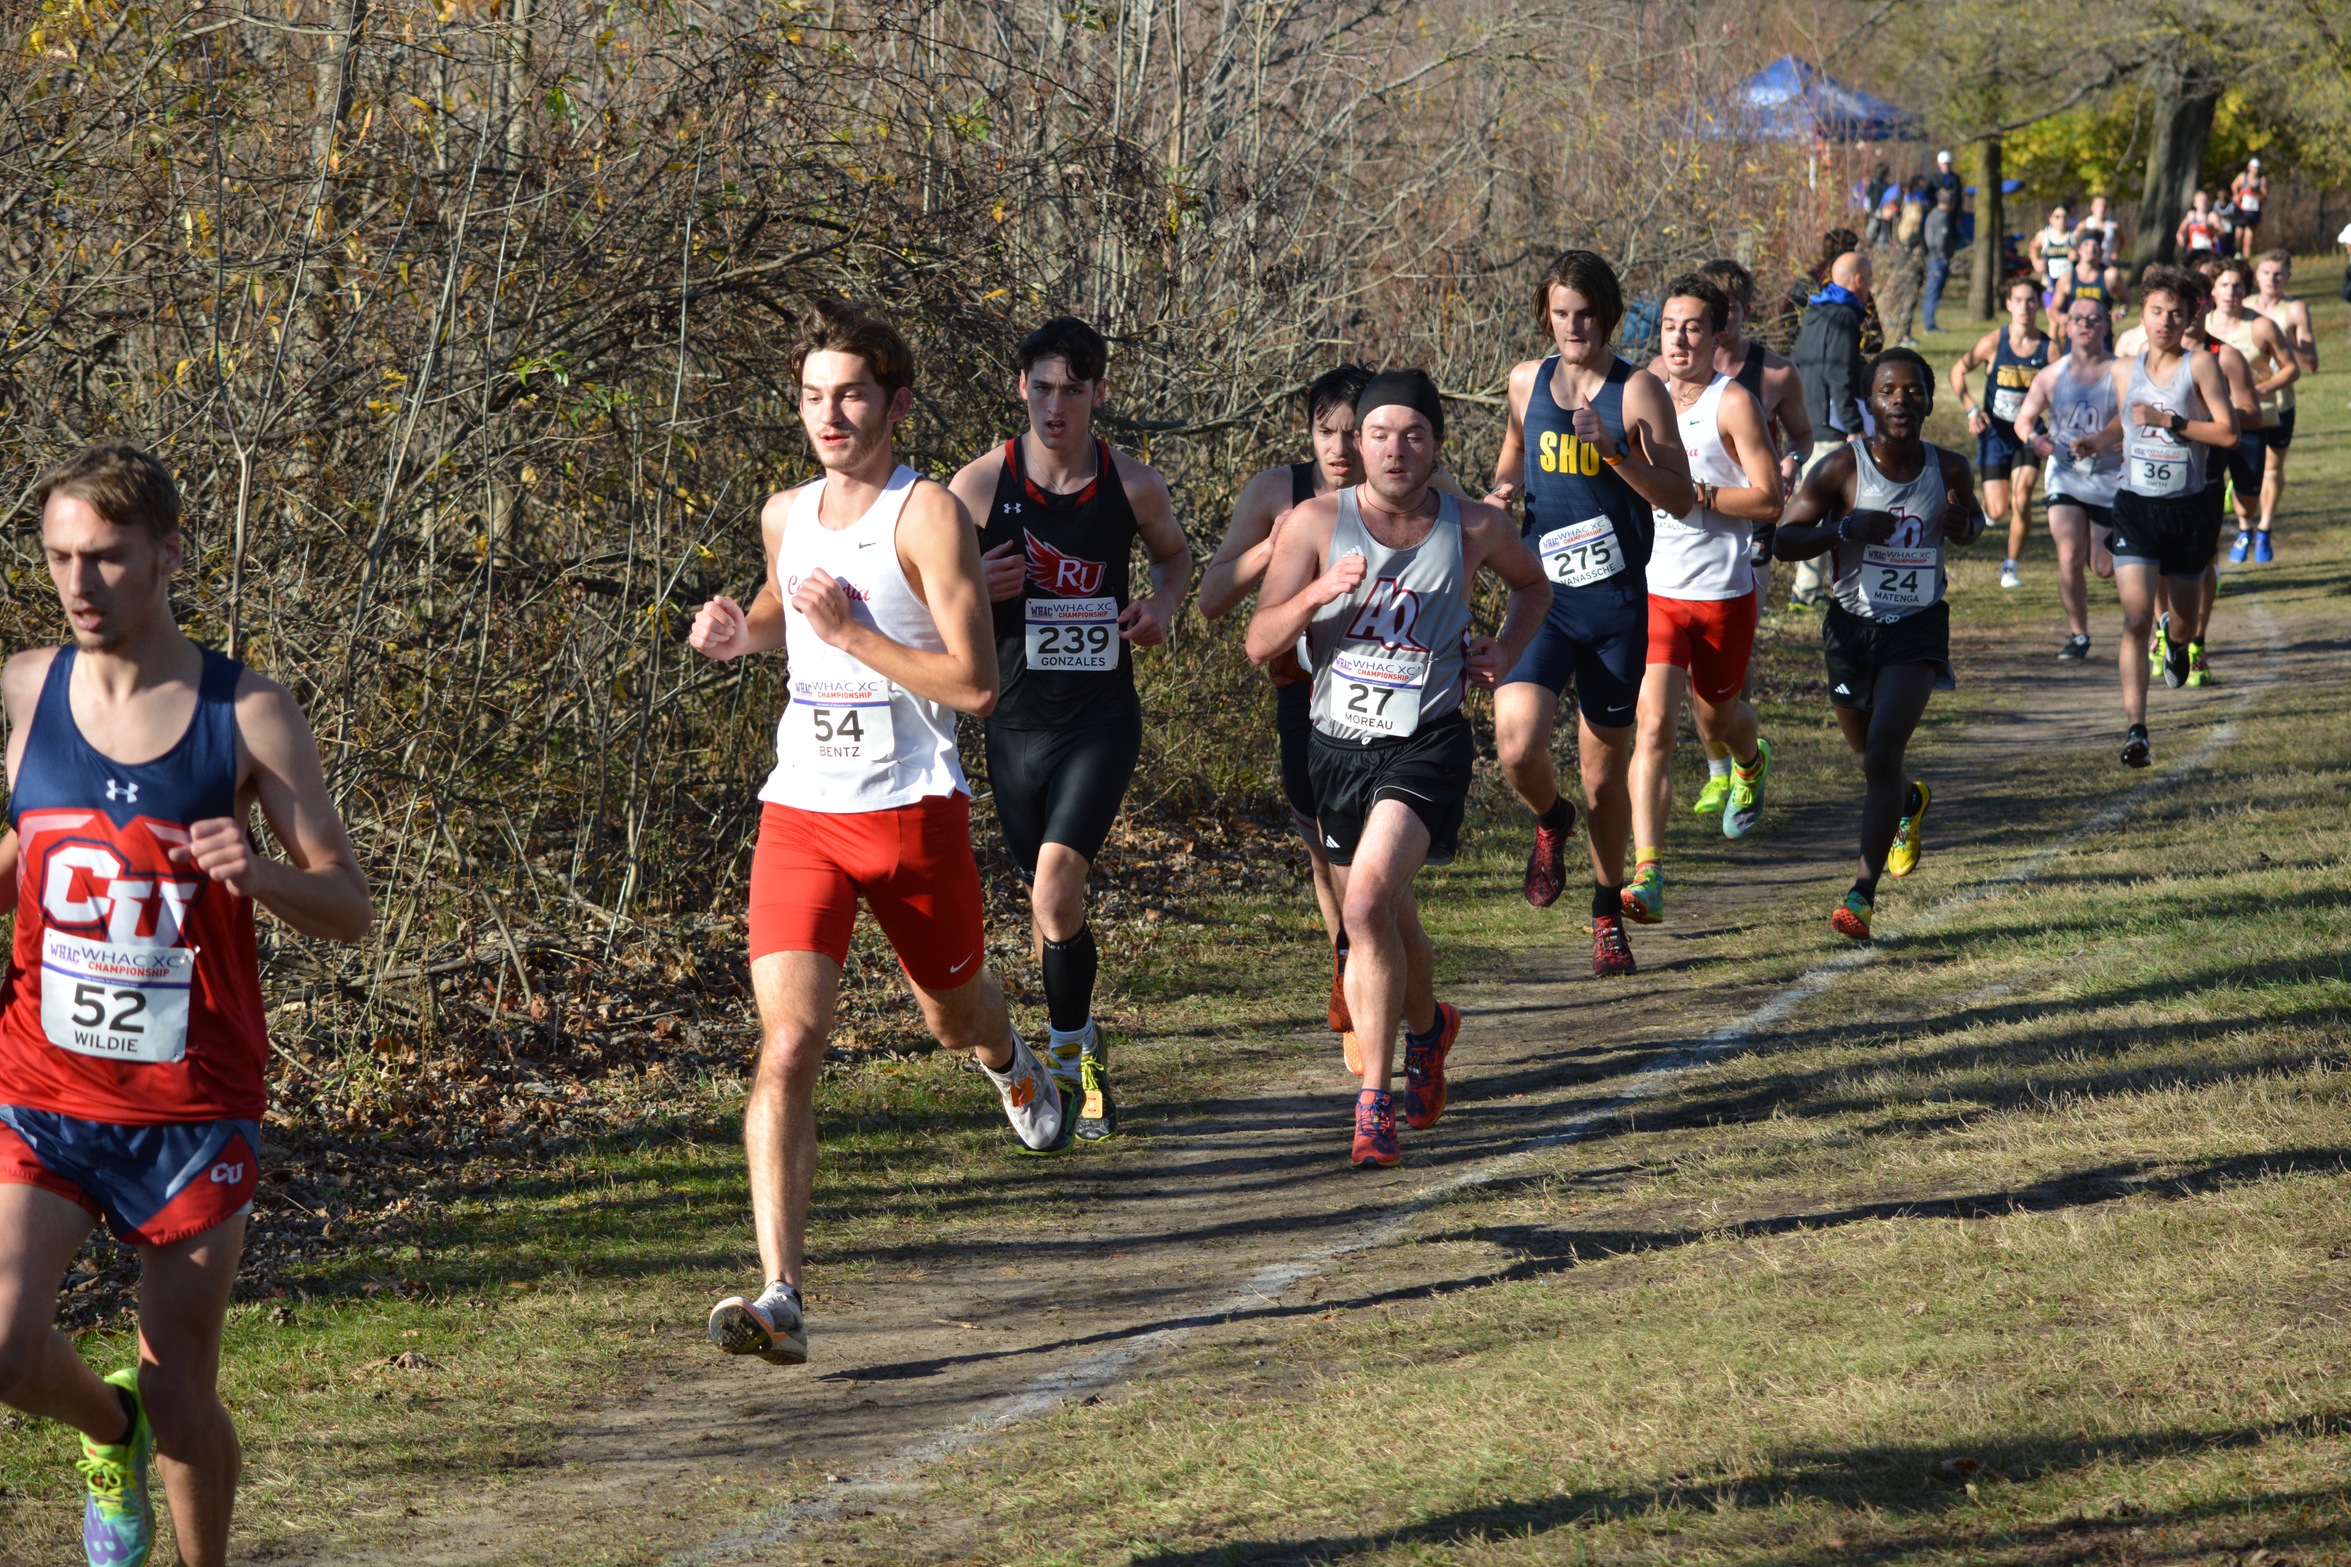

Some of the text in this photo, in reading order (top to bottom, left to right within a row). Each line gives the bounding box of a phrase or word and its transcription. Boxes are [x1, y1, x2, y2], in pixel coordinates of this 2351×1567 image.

[1539, 430, 1600, 477] SHU
[2143, 462, 2171, 480] 36
[2146, 480, 2168, 488] SMITH
[1558, 520, 1605, 540] WHAC XC
[1564, 528, 1602, 545] CHAMPIONSHIP
[1554, 540, 1611, 577] 275
[1886, 551, 1932, 559] WHAC XC
[1055, 559, 1103, 593] RU
[1879, 568, 1918, 593] 24
[1873, 591, 1920, 603] MATENGA
[1031, 606, 1053, 617] WHAC
[1053, 602, 1113, 612] WHAC XC
[1345, 577, 1431, 652] AQ
[1037, 626, 1110, 654] 239
[1041, 656, 1106, 667] GONZALES
[1353, 659, 1416, 676] WHAC XC
[1357, 668, 1409, 681] CHAMPIONSHIP
[795, 682, 813, 695] WHAC
[812, 681, 879, 692] WHAC XC
[817, 691, 873, 699] CHAMPIONSHIP
[1347, 683, 1395, 716] 27
[813, 709, 865, 743] 54
[1344, 713, 1394, 731] MOREAU
[819, 746, 861, 758] BENTZ
[42, 845, 199, 948] CU
[50, 943, 81, 964] WHAC
[82, 947, 181, 969] WHAC XC
[88, 961, 170, 978] CHAMPIONSHIP
[71, 983, 147, 1034] 52
[74, 1030, 139, 1054] WILDIE
[210, 1162, 244, 1185] CU
